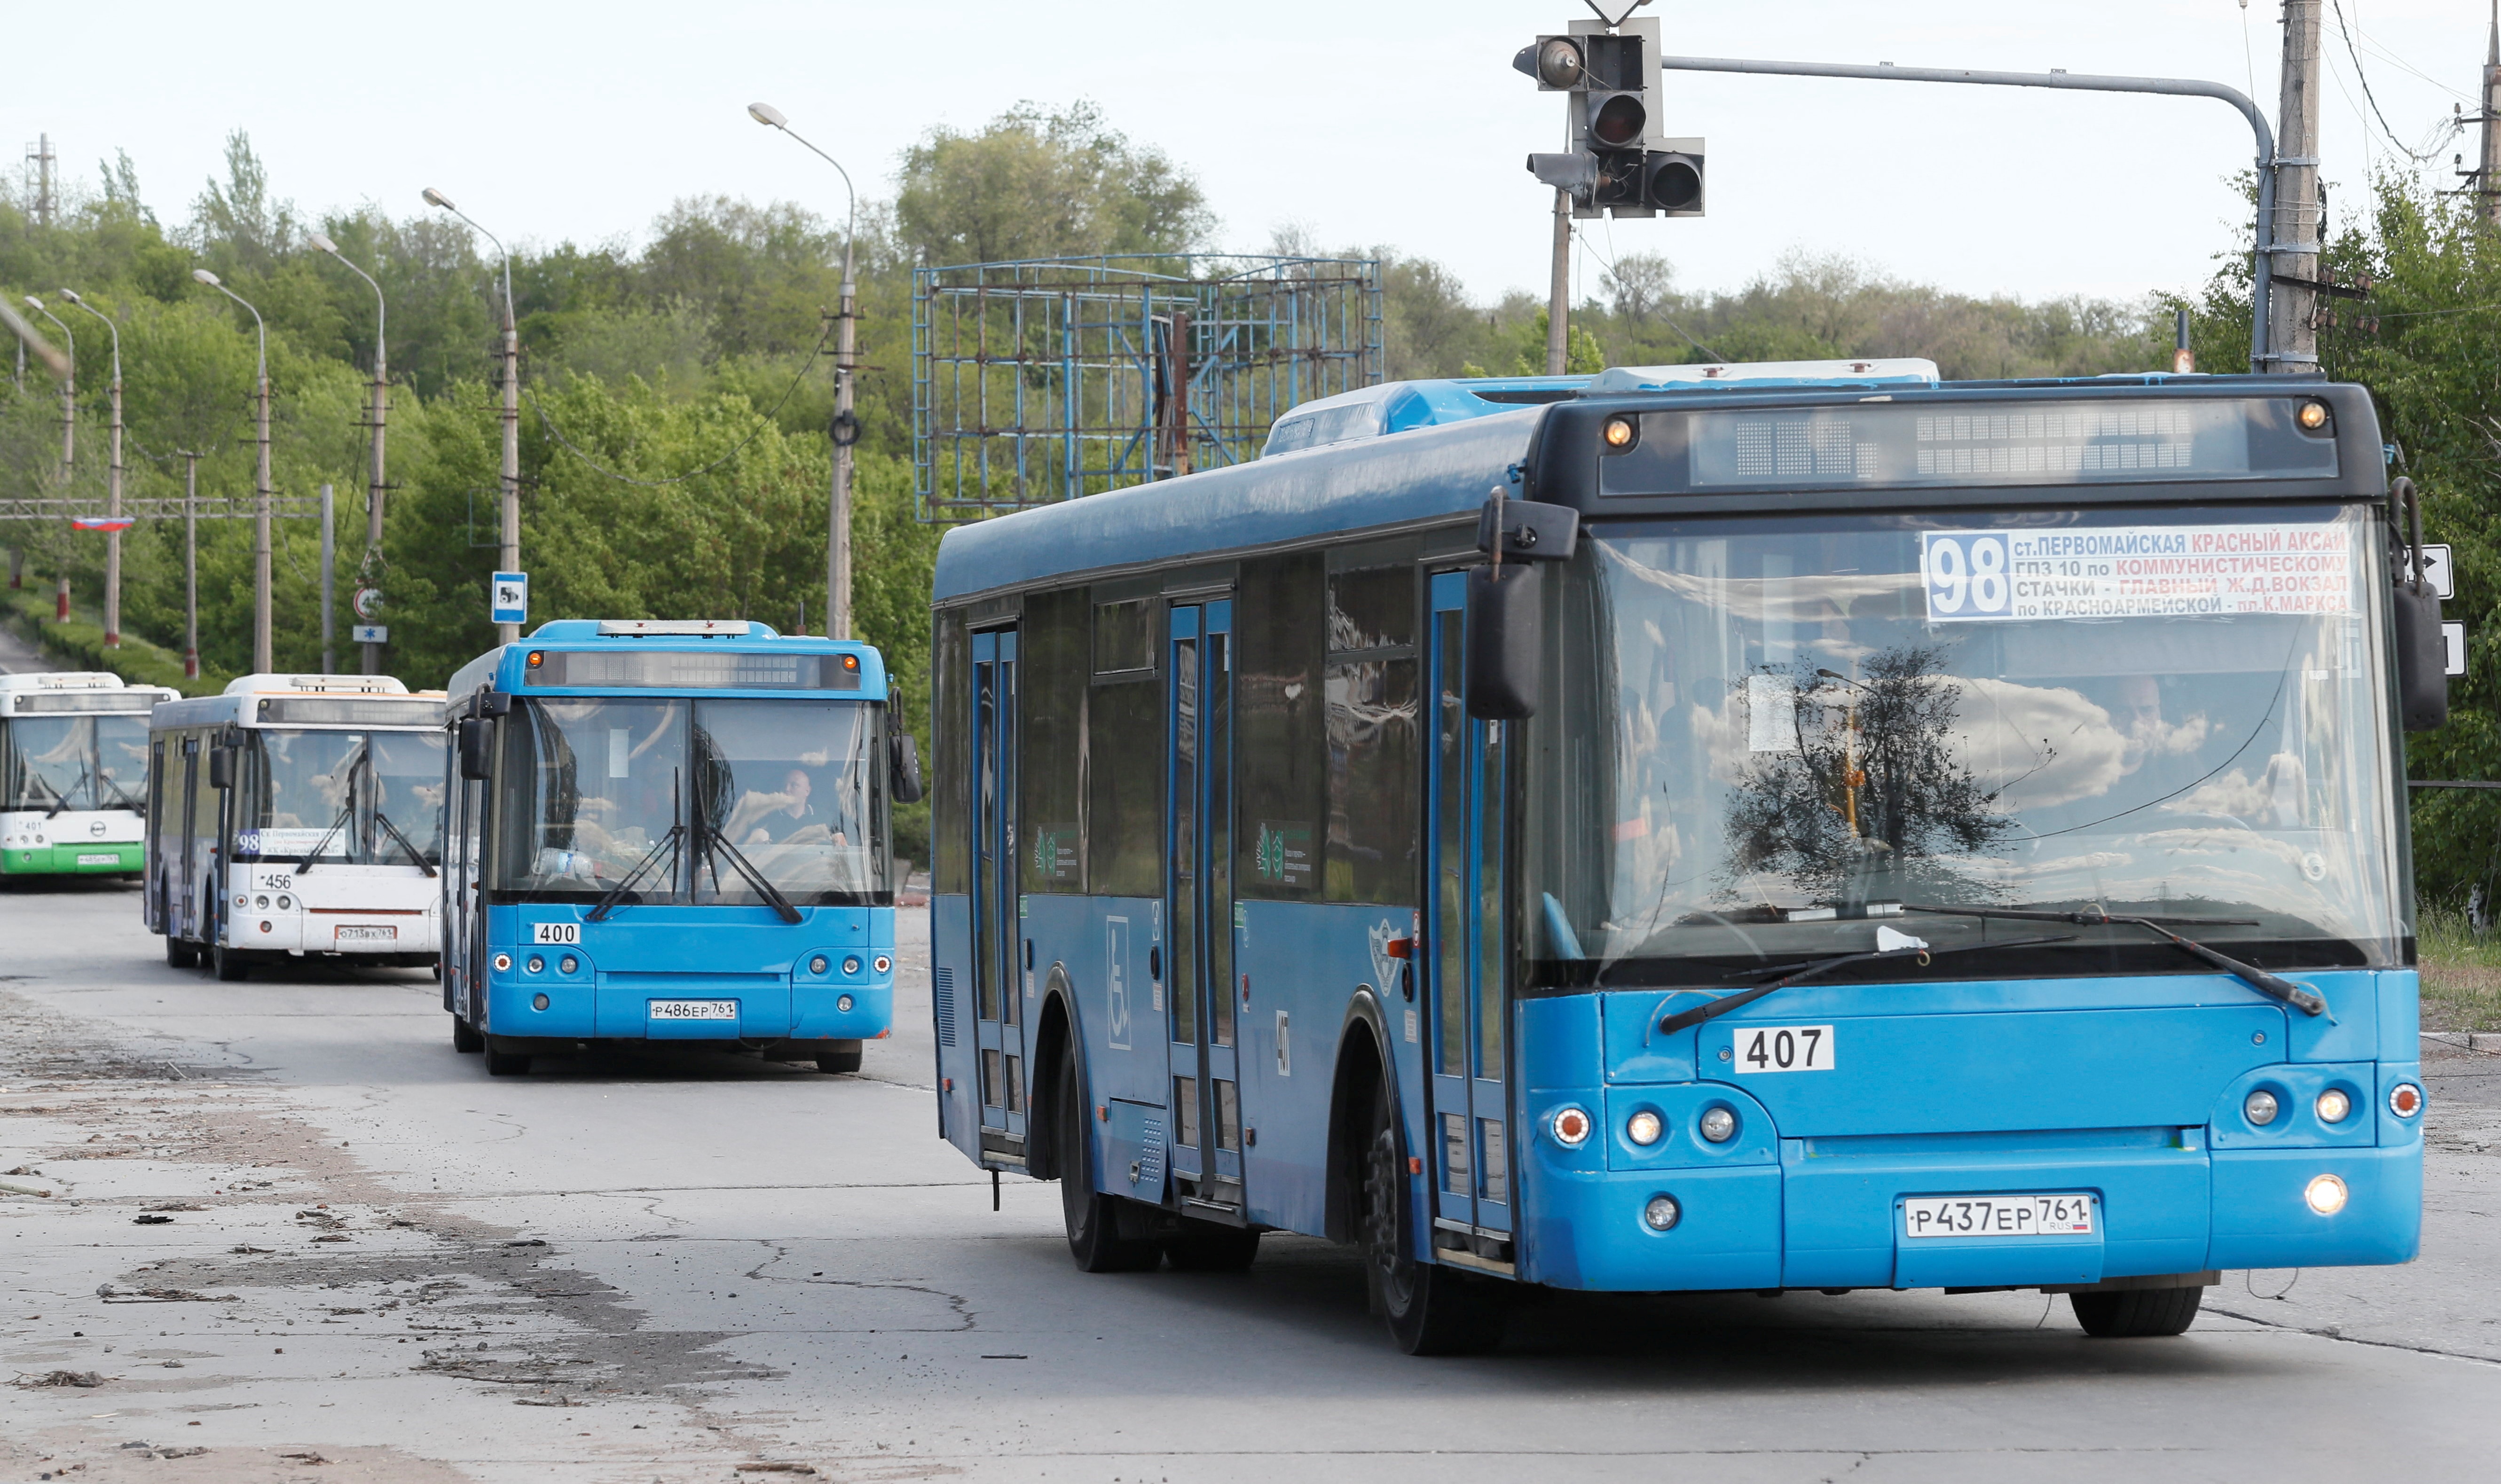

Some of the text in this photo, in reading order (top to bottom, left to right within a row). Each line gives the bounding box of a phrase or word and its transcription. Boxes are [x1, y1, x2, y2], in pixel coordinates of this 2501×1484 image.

[2192, 528, 2281, 552] КРАСНЫЙ
[1929, 537, 2008, 613] 98
[2015, 556, 2347, 577] ГПЗ 10 по КОММУНИСТИЧЕСКОМУ
[2017, 581, 2095, 597] СТАЧКИ
[2119, 574, 2218, 595] ГЛАВНЫЙ
[2018, 604, 2037, 616] по
[2043, 594, 2222, 616] КРАСНОАРМЕЙСКОЙ
[239, 834, 259, 851] 98
[266, 874, 291, 889] 456
[540, 925, 574, 942] 400
[712, 1003, 732, 1013] 761
[1746, 1029, 1821, 1069] 407
[2038, 1199, 2084, 1221] 761
[2050, 1222, 2071, 1230] RUS
